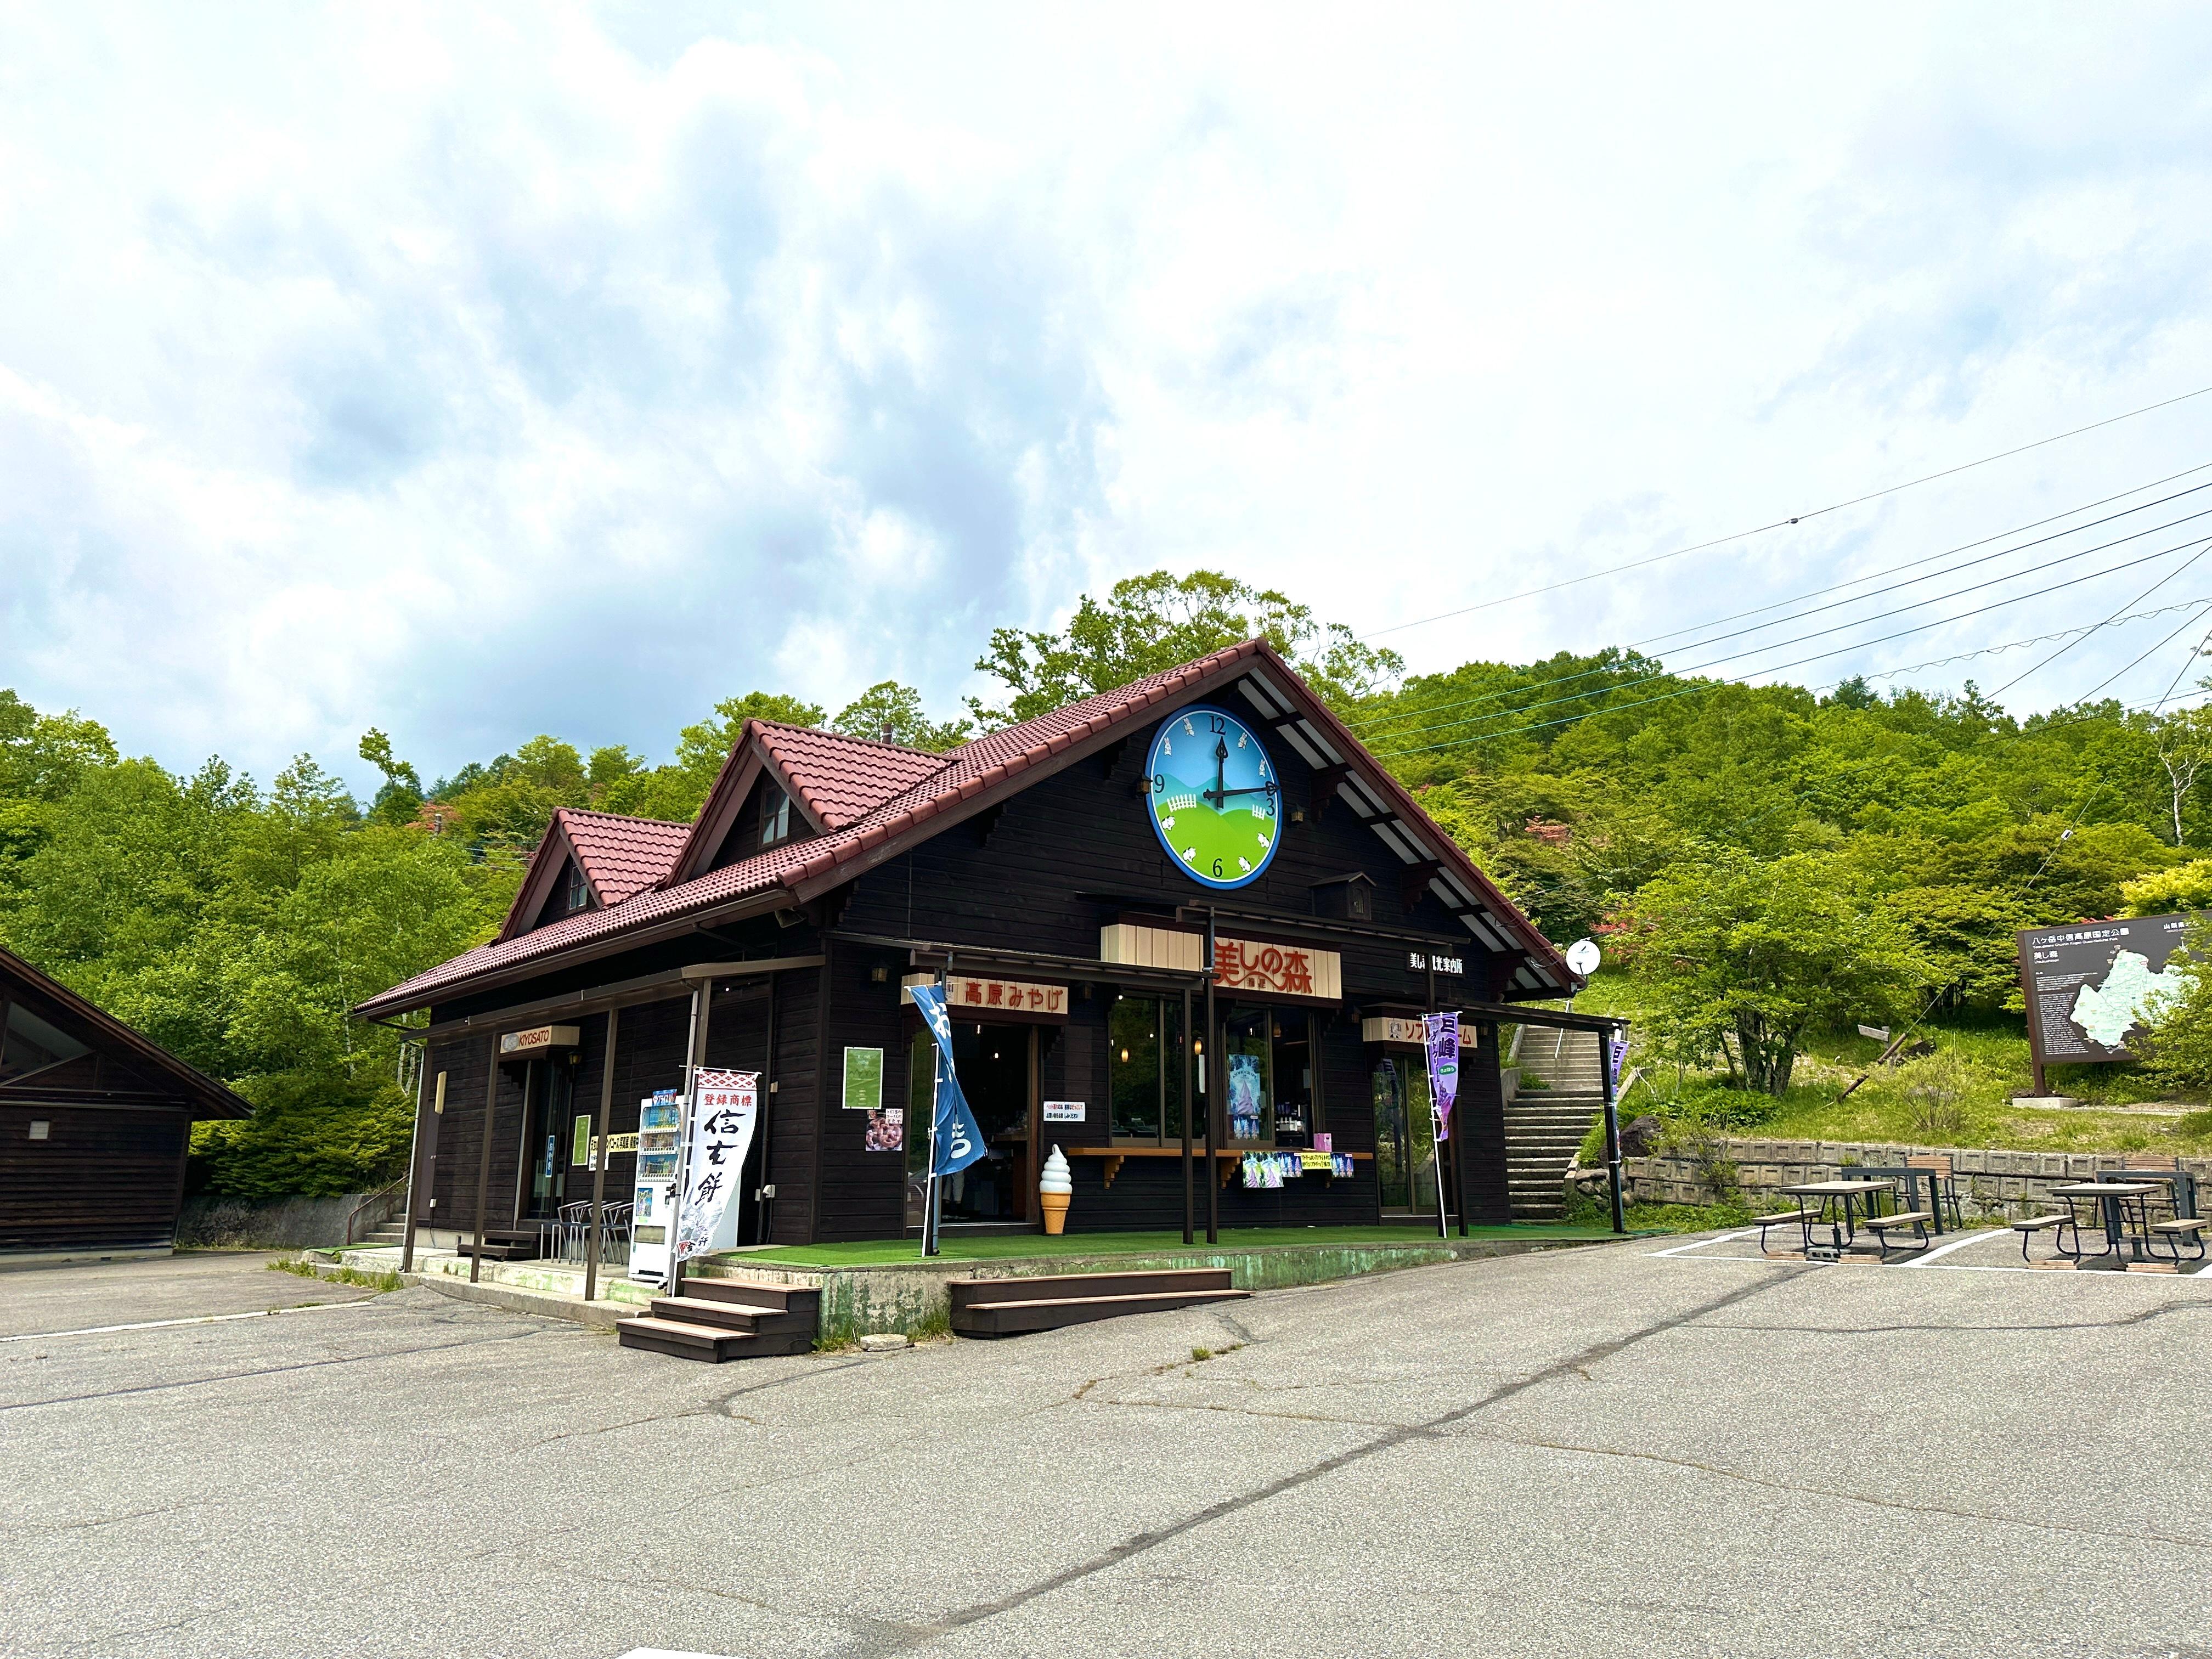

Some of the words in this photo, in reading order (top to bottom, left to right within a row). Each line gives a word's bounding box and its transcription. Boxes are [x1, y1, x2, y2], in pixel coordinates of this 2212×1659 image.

[1209, 715, 1226, 735] 12
[1154, 774, 1165, 793] 9
[1266, 798, 1275, 816] 3
[1212, 858, 1222, 877] 6
[1213, 941, 1312, 994] 美しの森
[966, 982, 1063, 1010] 高原みやげ
[518, 1029, 549, 1047] KIYOSATO
[1438, 1016, 1455, 1059] 巨峰
[704, 1093, 752, 1107] 登録商標
